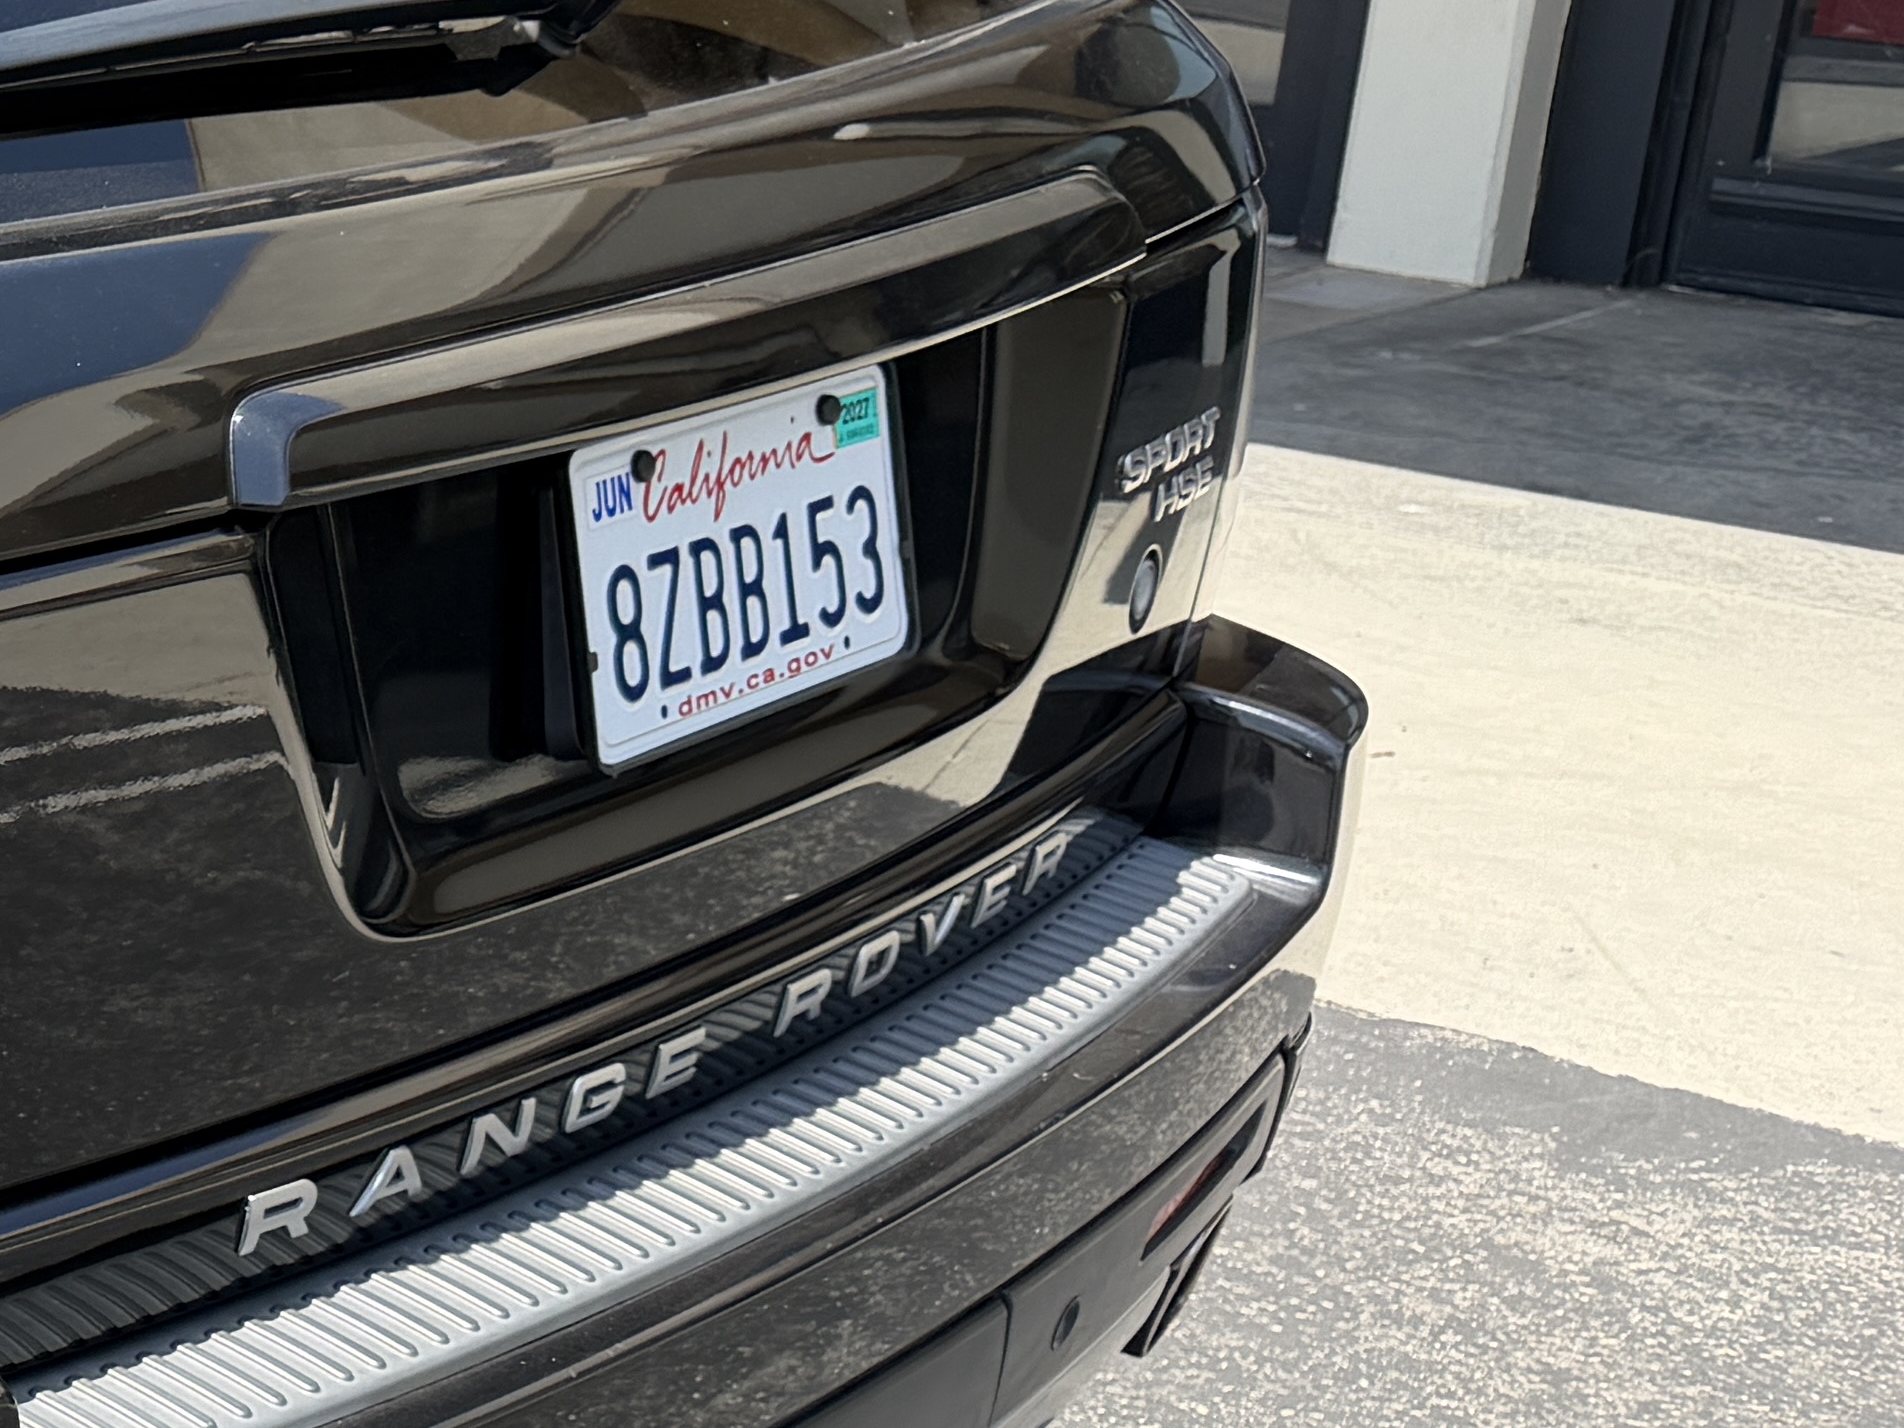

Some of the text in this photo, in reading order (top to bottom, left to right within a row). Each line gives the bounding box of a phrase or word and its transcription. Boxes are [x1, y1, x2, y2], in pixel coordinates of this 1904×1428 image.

[841, 397, 870, 425] 2027
[1121, 406, 1221, 493] SPORT
[592, 472, 633, 522] JUN
[643, 427, 835, 522] California
[1153, 455, 1214, 522] HSE
[607, 485, 884, 703] 8ZBB153
[678, 644, 835, 718] dmv.ca.gov
[236, 832, 1069, 1256] RANGE ROVER
